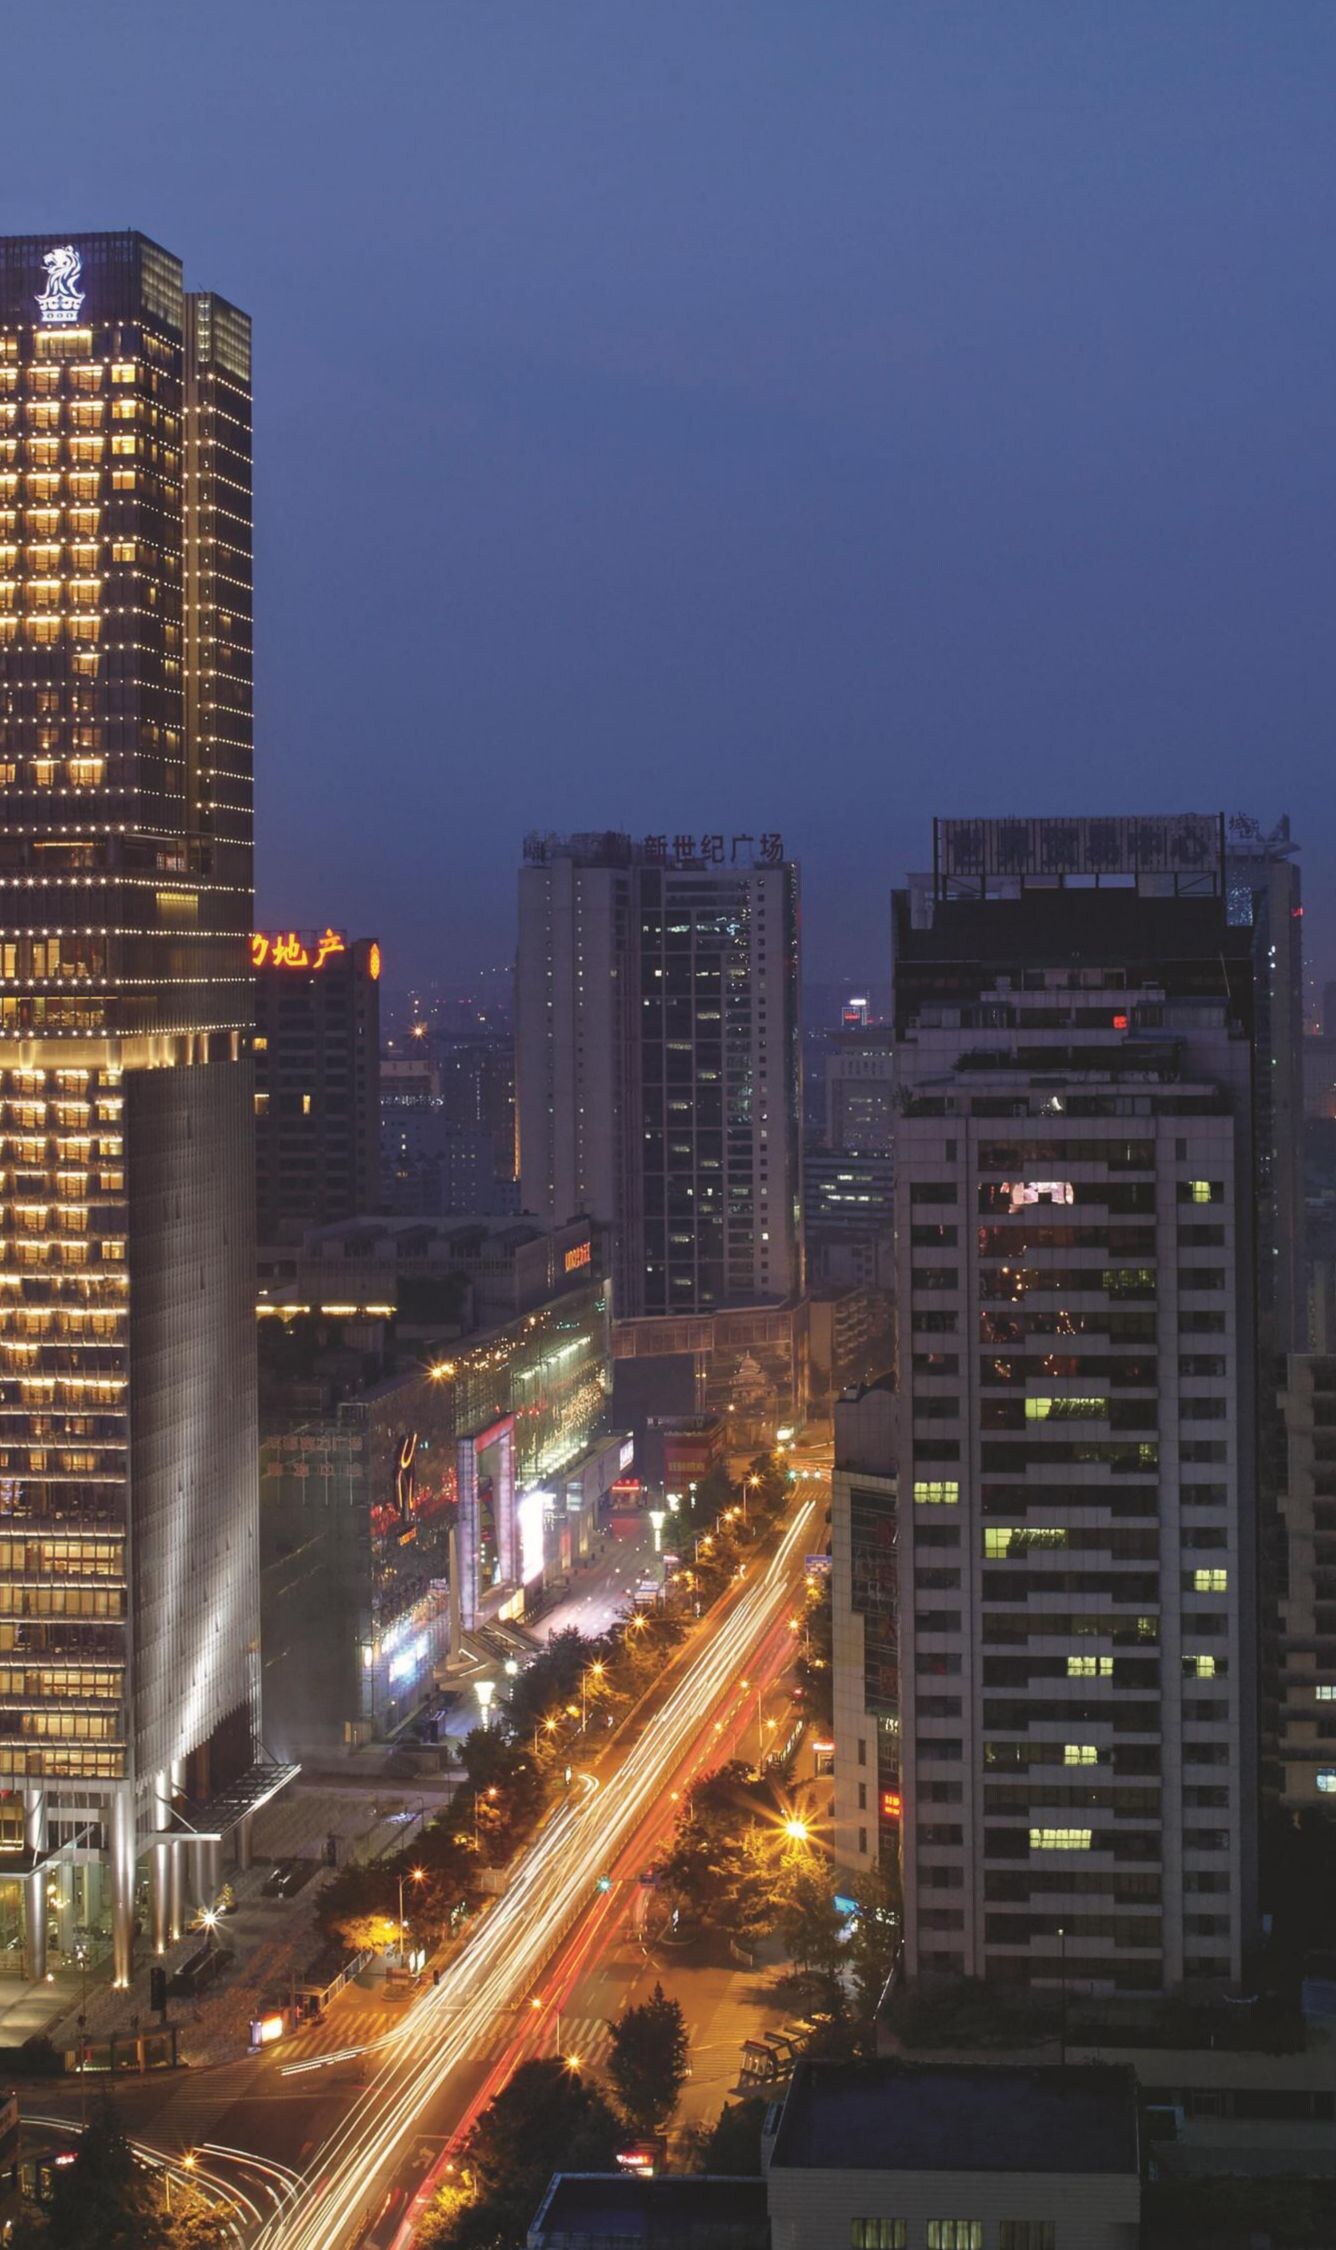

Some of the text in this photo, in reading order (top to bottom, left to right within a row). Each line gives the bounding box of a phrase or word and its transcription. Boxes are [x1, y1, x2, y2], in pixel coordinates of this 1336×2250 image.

[644, 833, 785, 864] 新世纪广场
